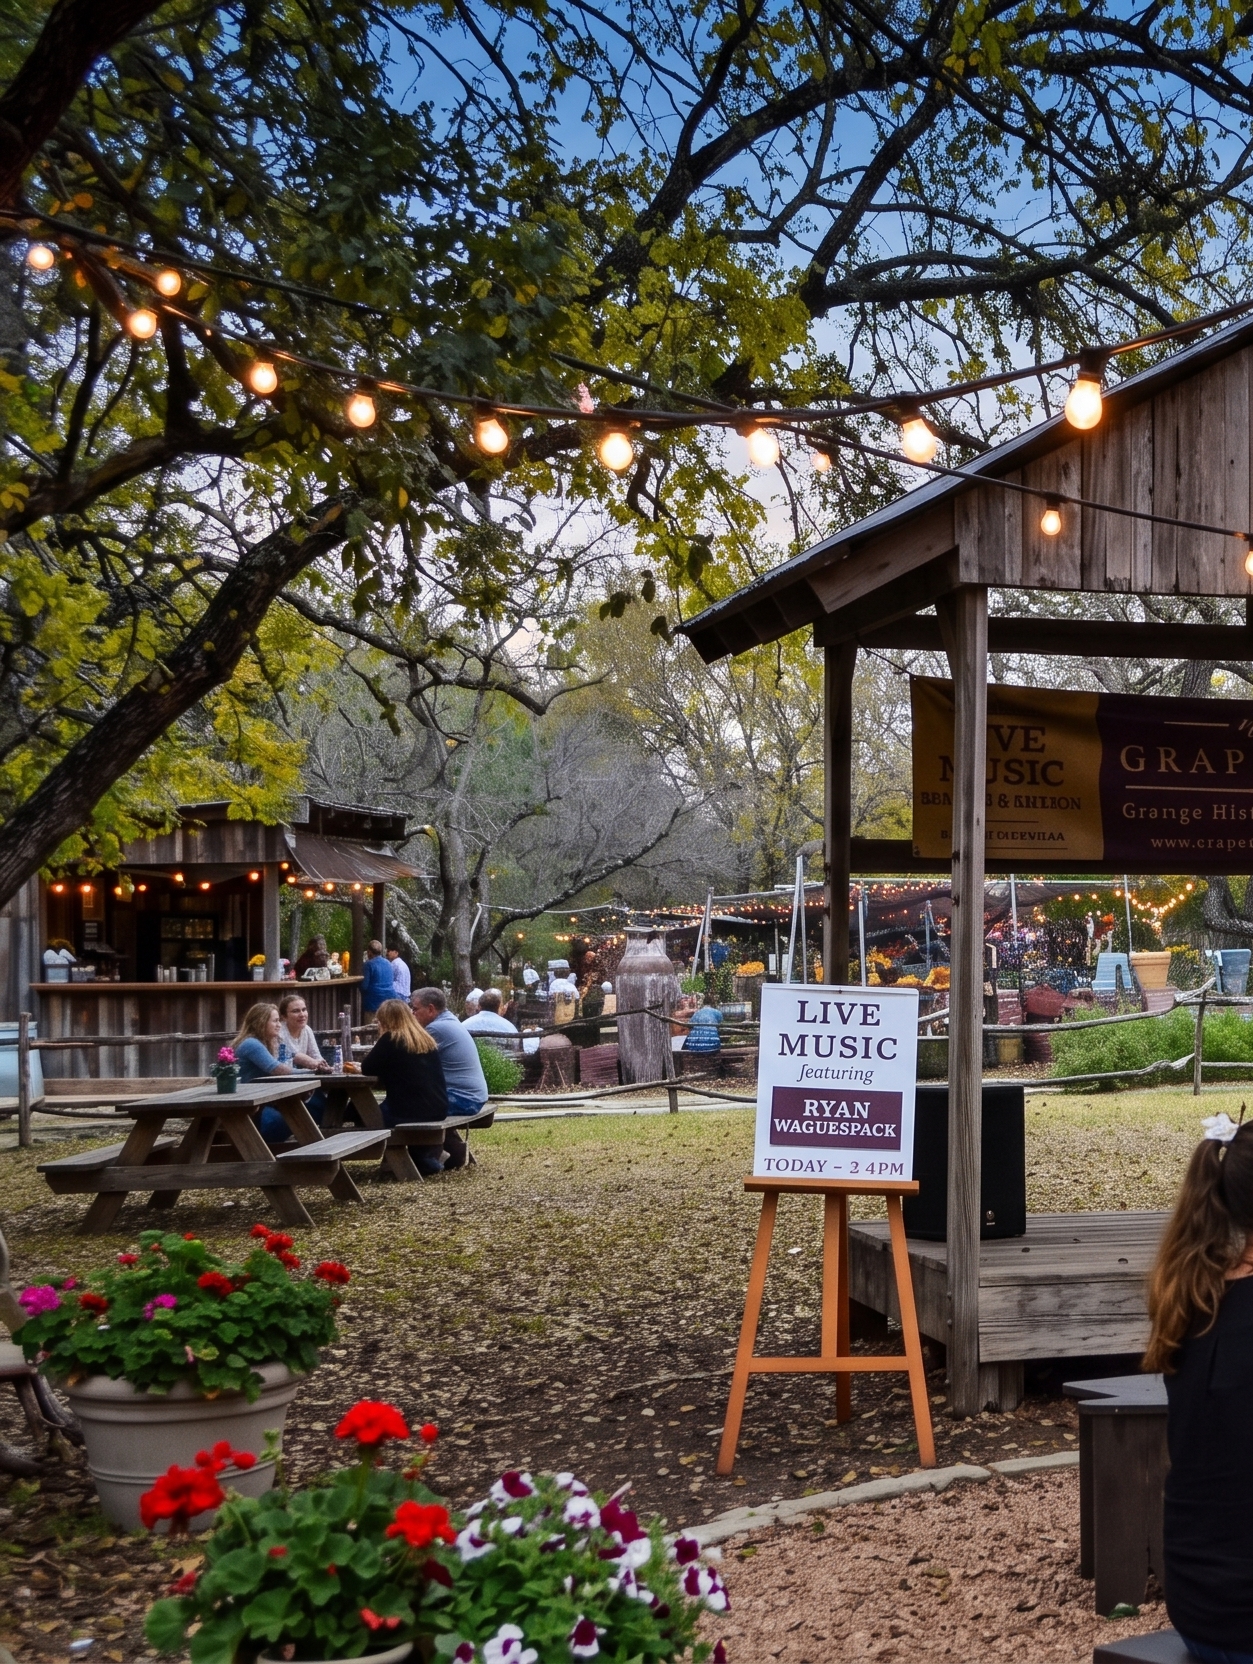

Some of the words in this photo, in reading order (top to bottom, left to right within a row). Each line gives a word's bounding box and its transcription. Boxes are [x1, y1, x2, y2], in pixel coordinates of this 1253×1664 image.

[796, 1000, 881, 1026] LIVE
[777, 1033, 898, 1060] MUSIC
[796, 1064, 875, 1085] featuring
[802, 1099, 871, 1119] RYAN
[773, 1118, 897, 1138] WAGUESPACK
[763, 1157, 828, 1173] TODAY
[865, 1161, 905, 1176] 4PM
